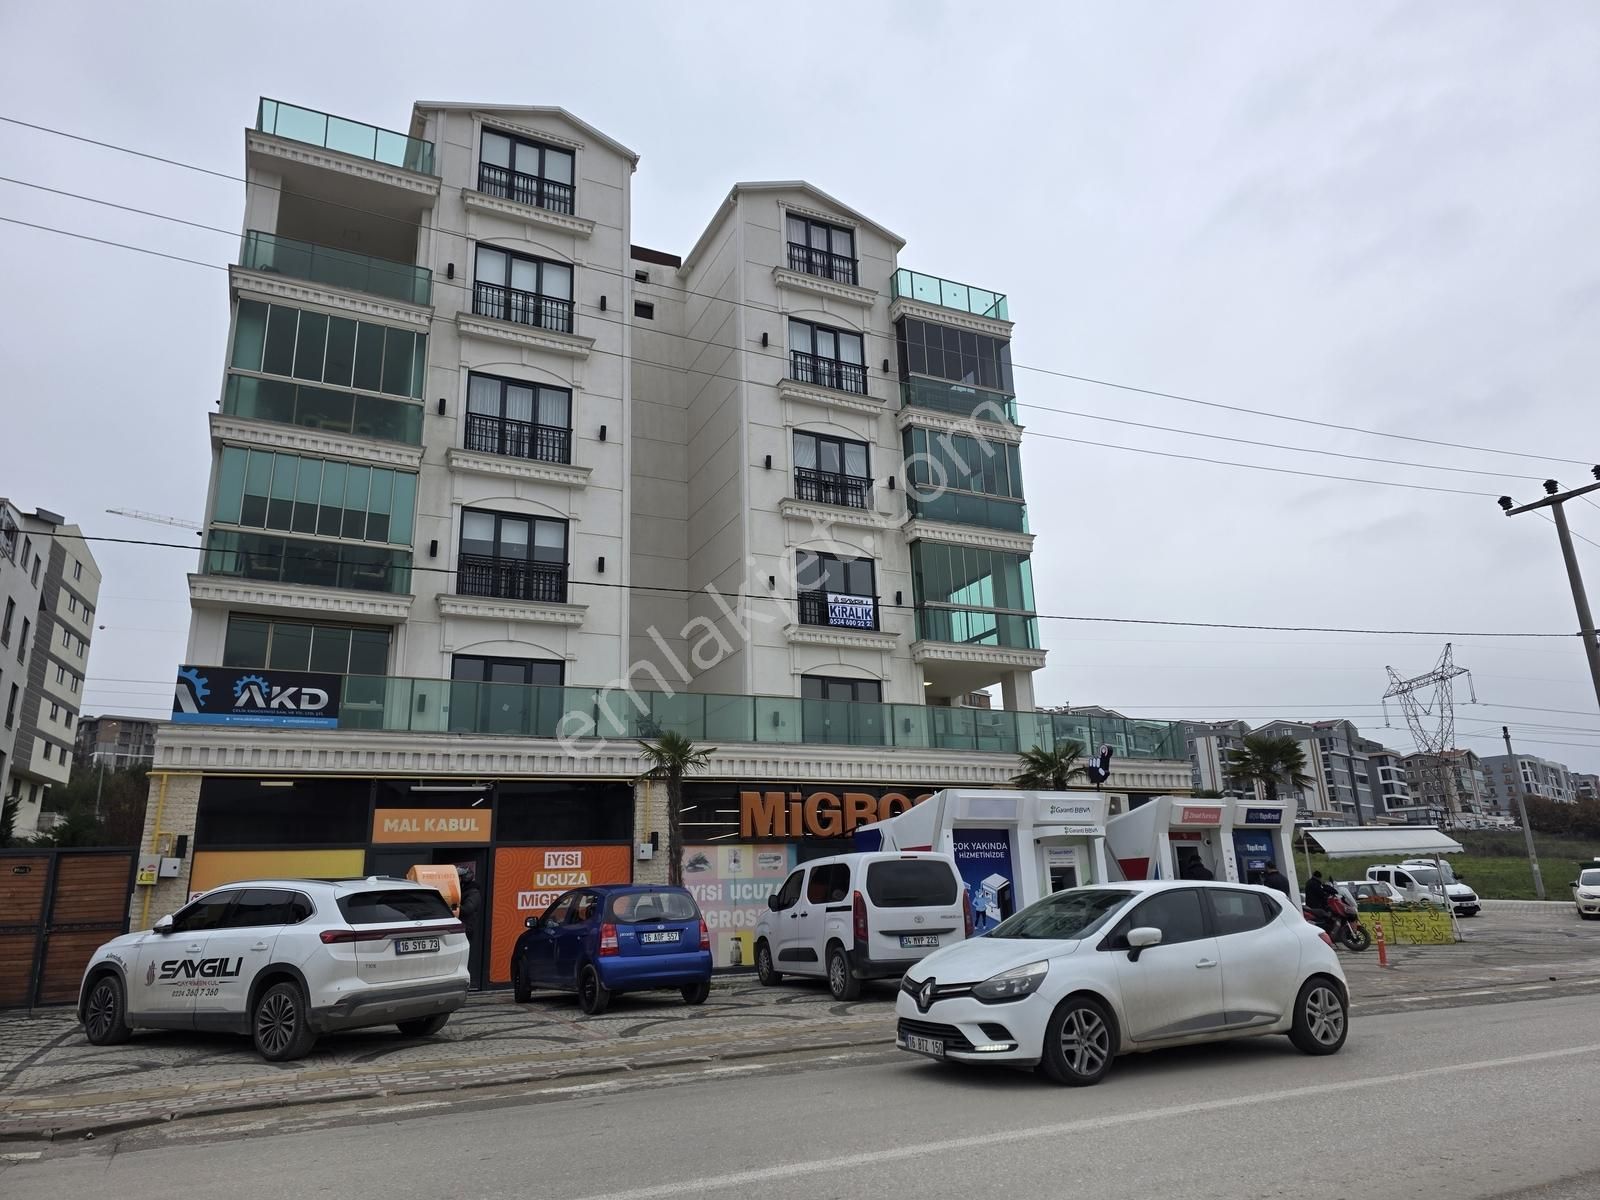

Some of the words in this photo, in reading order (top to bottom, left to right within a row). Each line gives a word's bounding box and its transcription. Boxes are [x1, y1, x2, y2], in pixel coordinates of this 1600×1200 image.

[234, 685, 328, 709] AKD
[740, 791, 935, 838] MiGRO
[383, 818, 420, 832] MAL
[424, 818, 479, 832] KABUL
[952, 842, 970, 851] ÇOK
[970, 842, 1008, 850] YAKINDA
[536, 873, 588, 886] UCUZA
[730, 883, 782, 900] UCUZ
[401, 942, 409, 950] 16
[412, 941, 426, 950] SYG
[429, 940, 438, 949] 73
[158, 957, 244, 979] SAYGILI
[205, 988, 219, 996] 360
